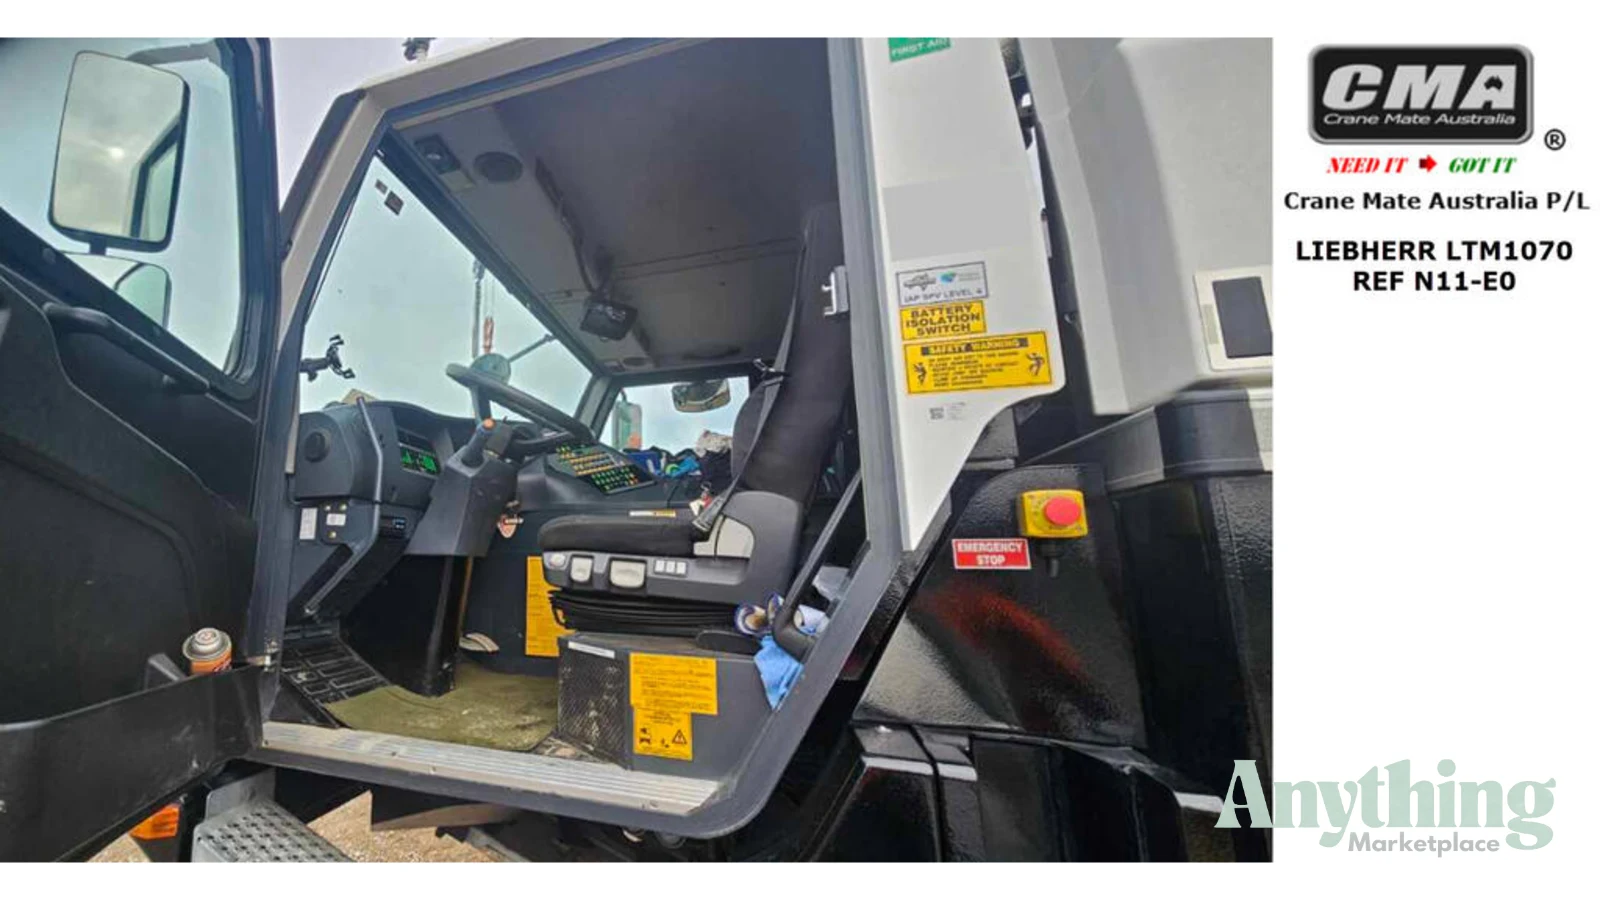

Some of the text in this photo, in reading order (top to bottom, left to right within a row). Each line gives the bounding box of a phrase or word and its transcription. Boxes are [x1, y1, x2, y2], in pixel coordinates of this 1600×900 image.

[891, 43, 923, 57] FIRST
[943, 288, 972, 299] LEVEL
[910, 303, 972, 318] BATTERY
[906, 312, 980, 328] ISOLATION
[917, 323, 971, 336] SWITCH
[929, 338, 1020, 355] SAFETY WARNING
[957, 542, 1023, 554] EMERGENCY
[976, 554, 1006, 566] STOP
